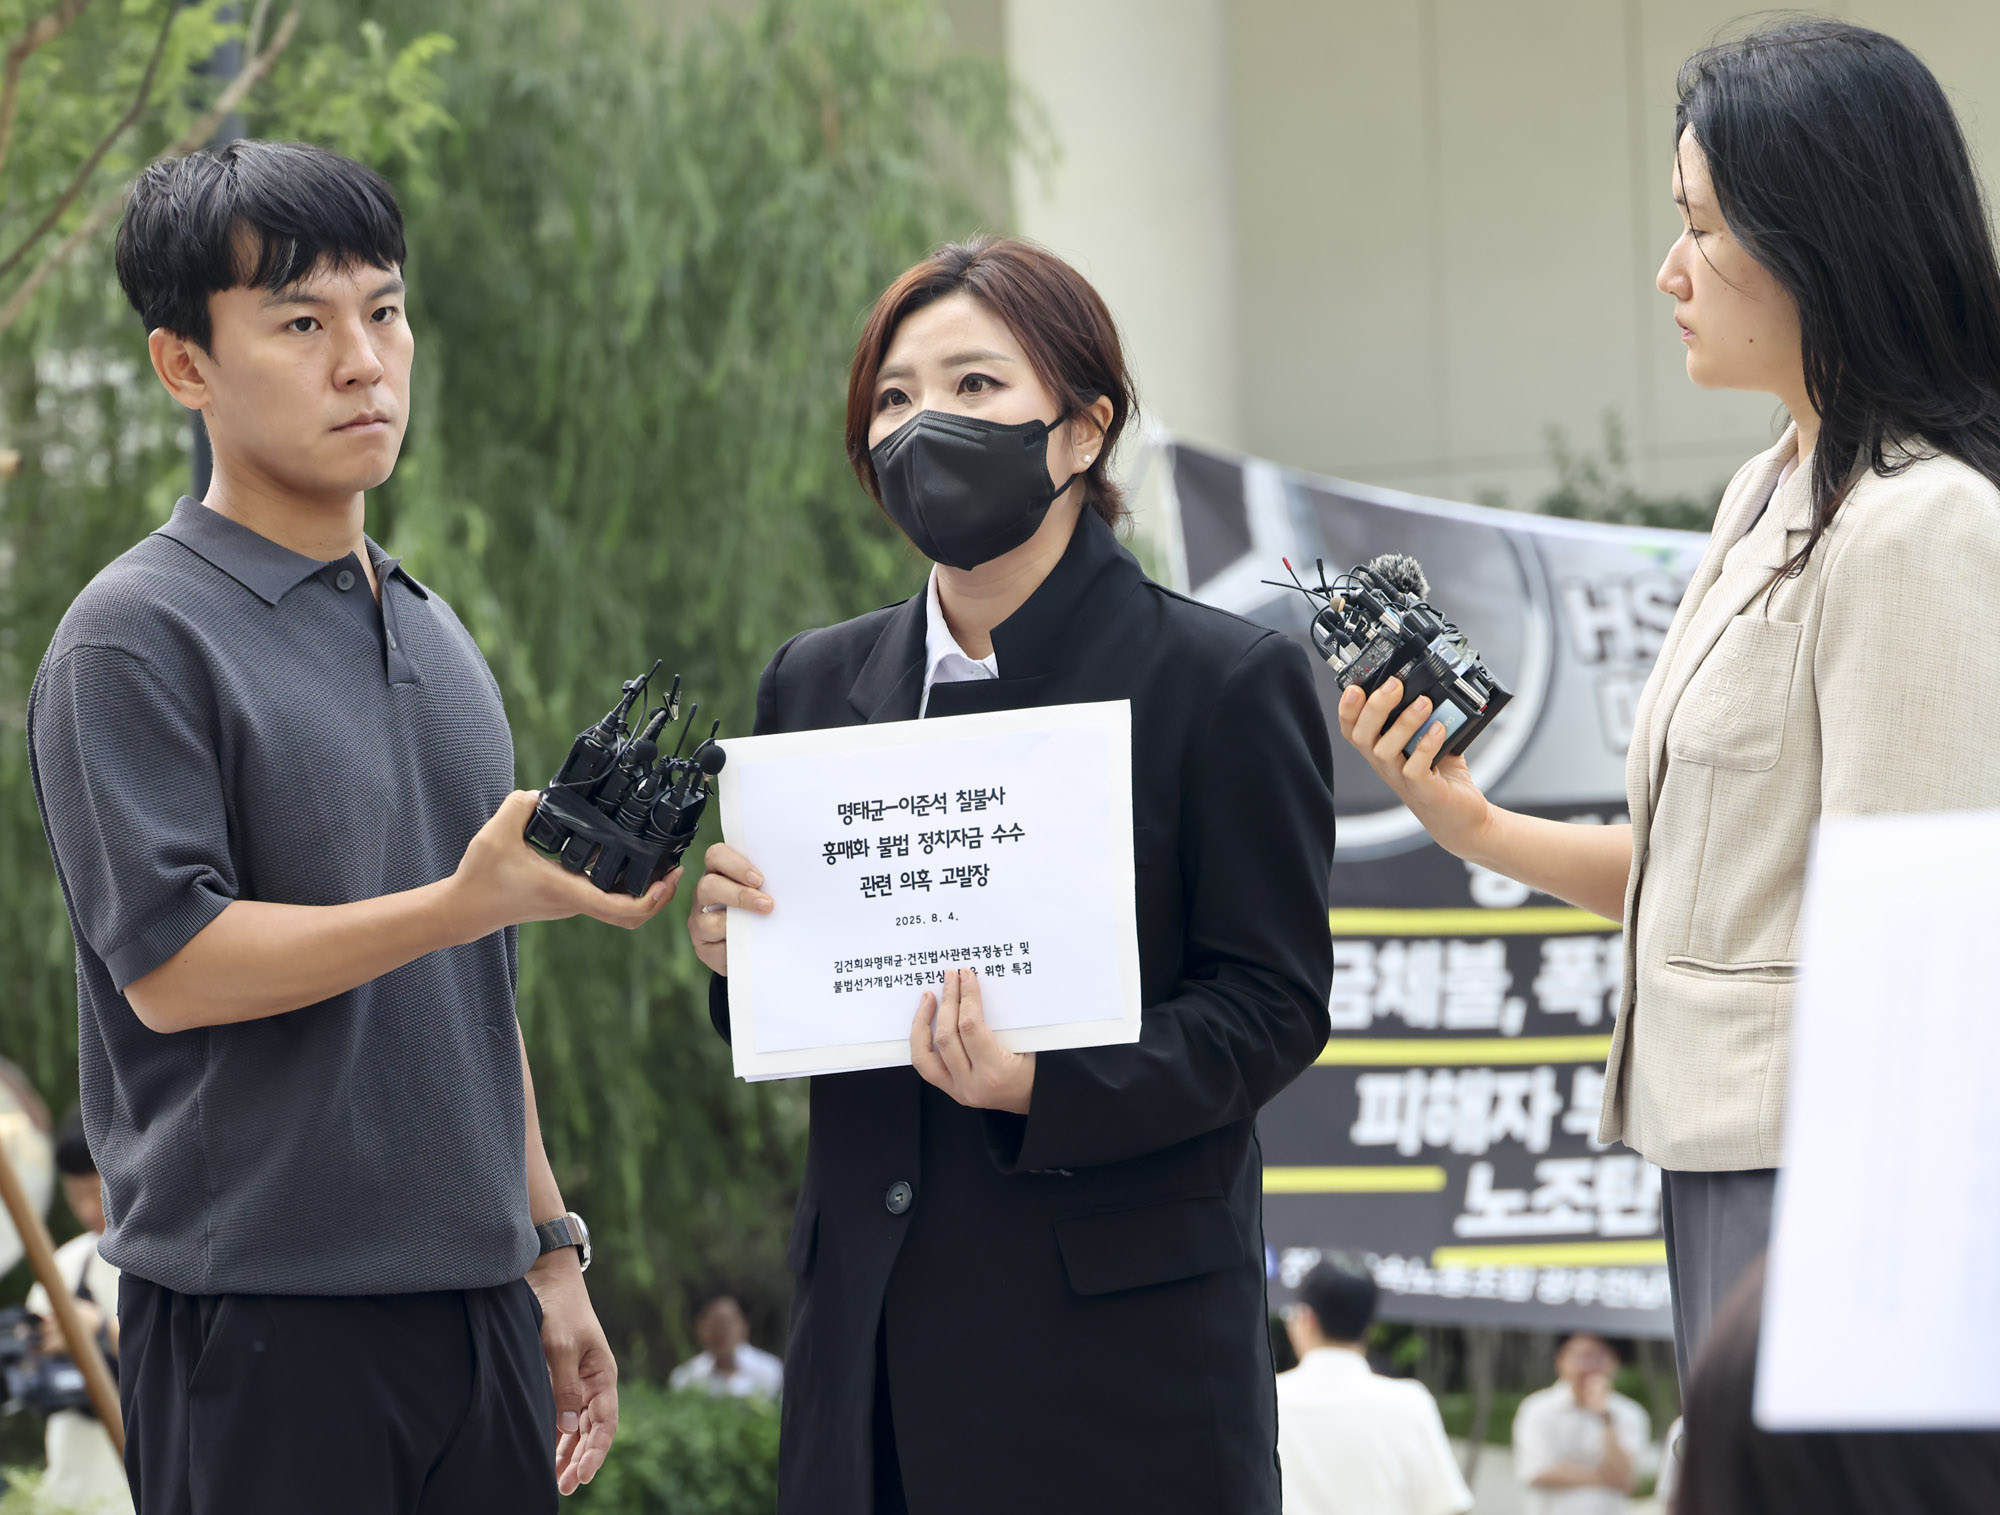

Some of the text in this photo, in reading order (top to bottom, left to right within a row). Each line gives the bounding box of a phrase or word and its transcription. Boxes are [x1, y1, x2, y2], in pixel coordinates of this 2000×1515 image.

[955, 786, 1006, 813] 칠불사
[821, 822, 1026, 866] 홍매화 불법 정치자금 수수
[859, 863, 991, 899] 관련 의혹 고발장
[895, 911, 960, 927] 2025. 8. 4.
[1019, 941, 1030, 955] 및
[984, 963, 1006, 977] 위한
[1011, 961, 1033, 976] 특검
[1349, 1066, 1563, 1158] 피해자
